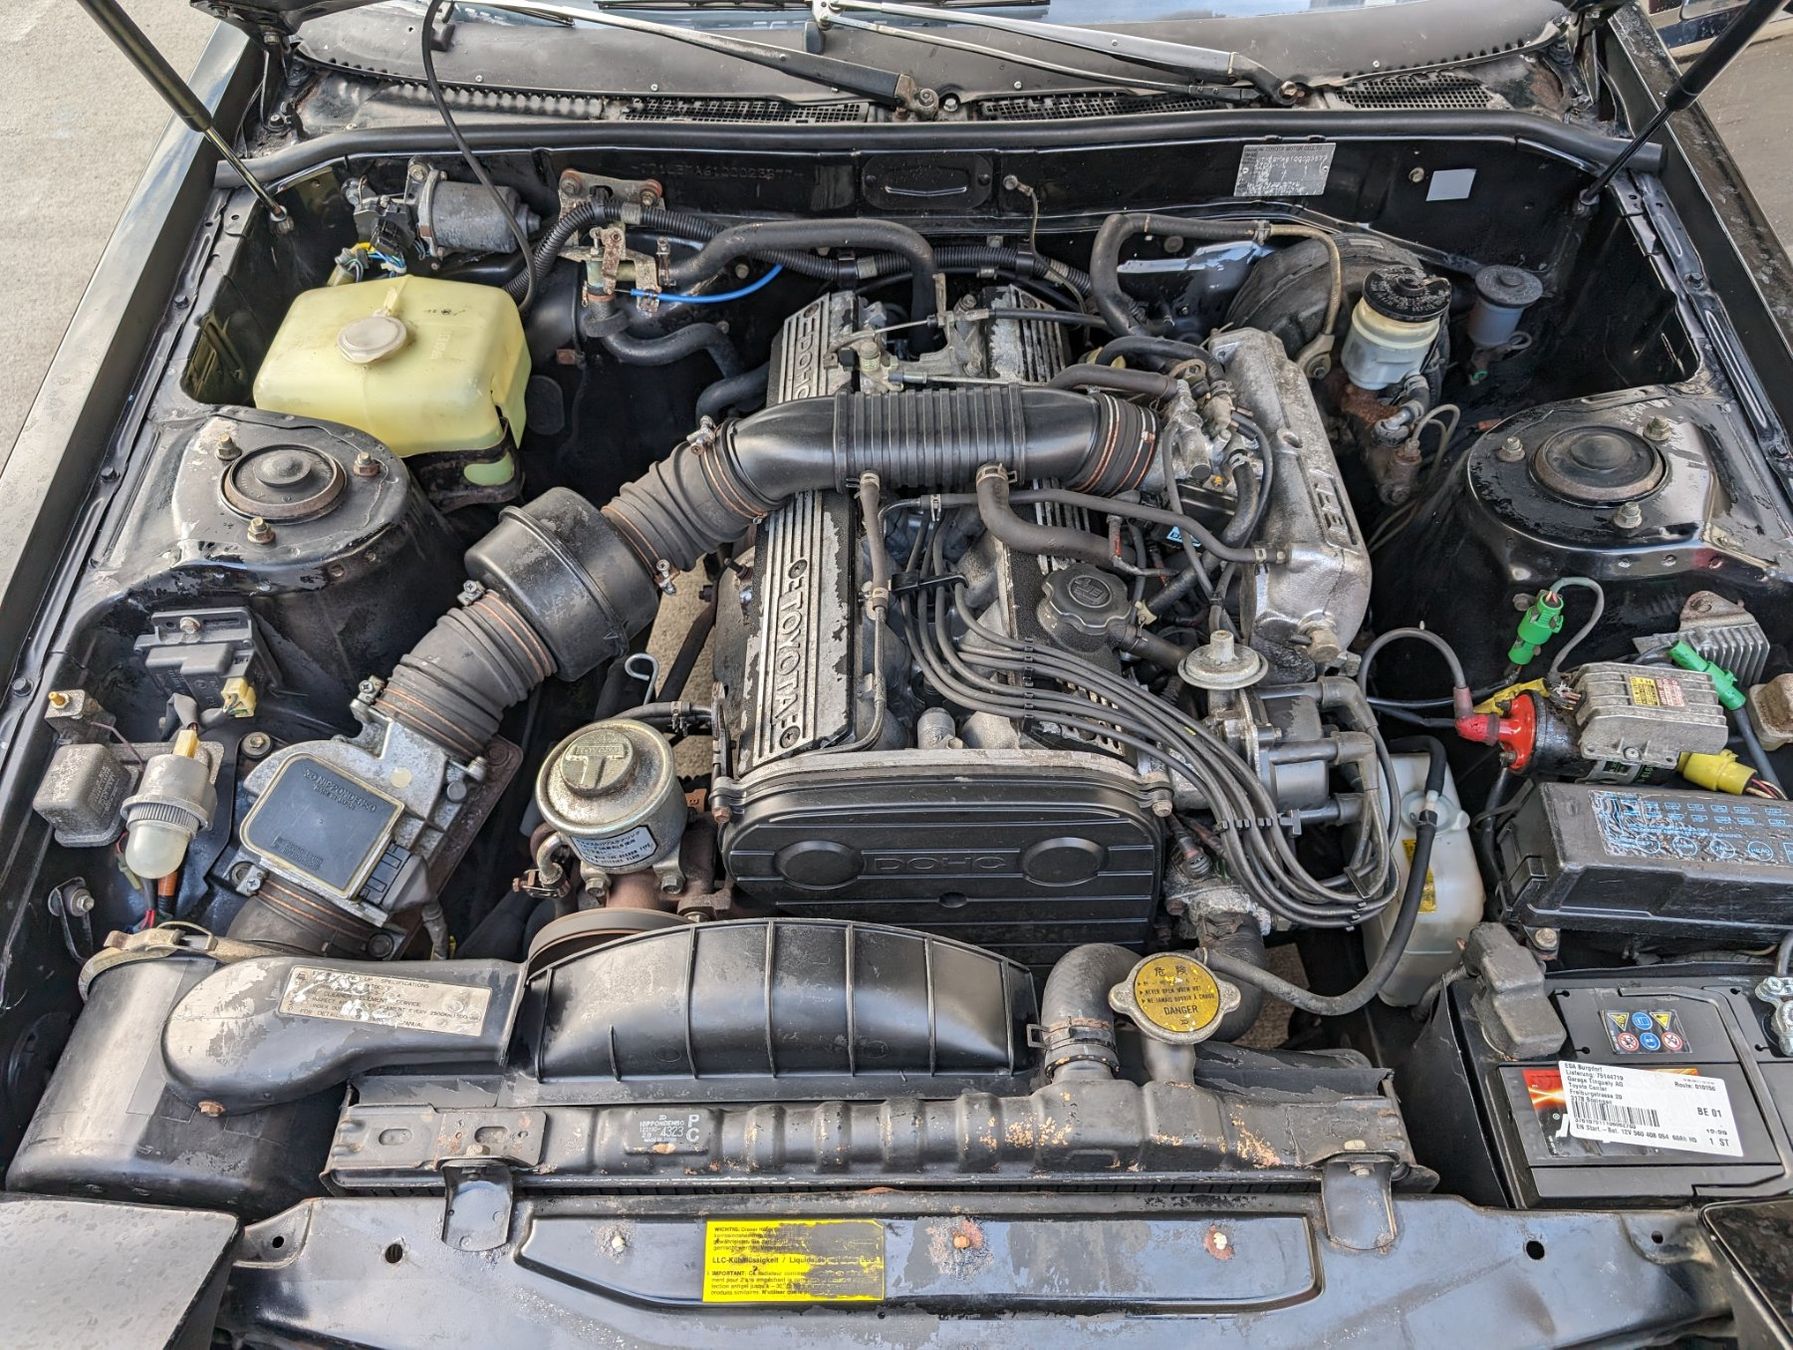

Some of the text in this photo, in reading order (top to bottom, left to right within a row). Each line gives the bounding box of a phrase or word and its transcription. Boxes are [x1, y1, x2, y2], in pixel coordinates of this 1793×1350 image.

[775, 591, 803, 720] TOYOTA
[874, 857, 1006, 870] DOHC
[1163, 1004, 1198, 1016] DANGER
[1566, 1070, 1594, 1078] Lieferung:
[1567, 1075, 1588, 1084] Garage
[1568, 1082, 1588, 1090] Toyota
[1697, 1106, 1722, 1118] BE 01
[640, 1119, 685, 1127] NIPPONDENSO
[687, 1114, 700, 1128] P
[686, 1127, 700, 1142] C
[1718, 1138, 1729, 1147] ST
